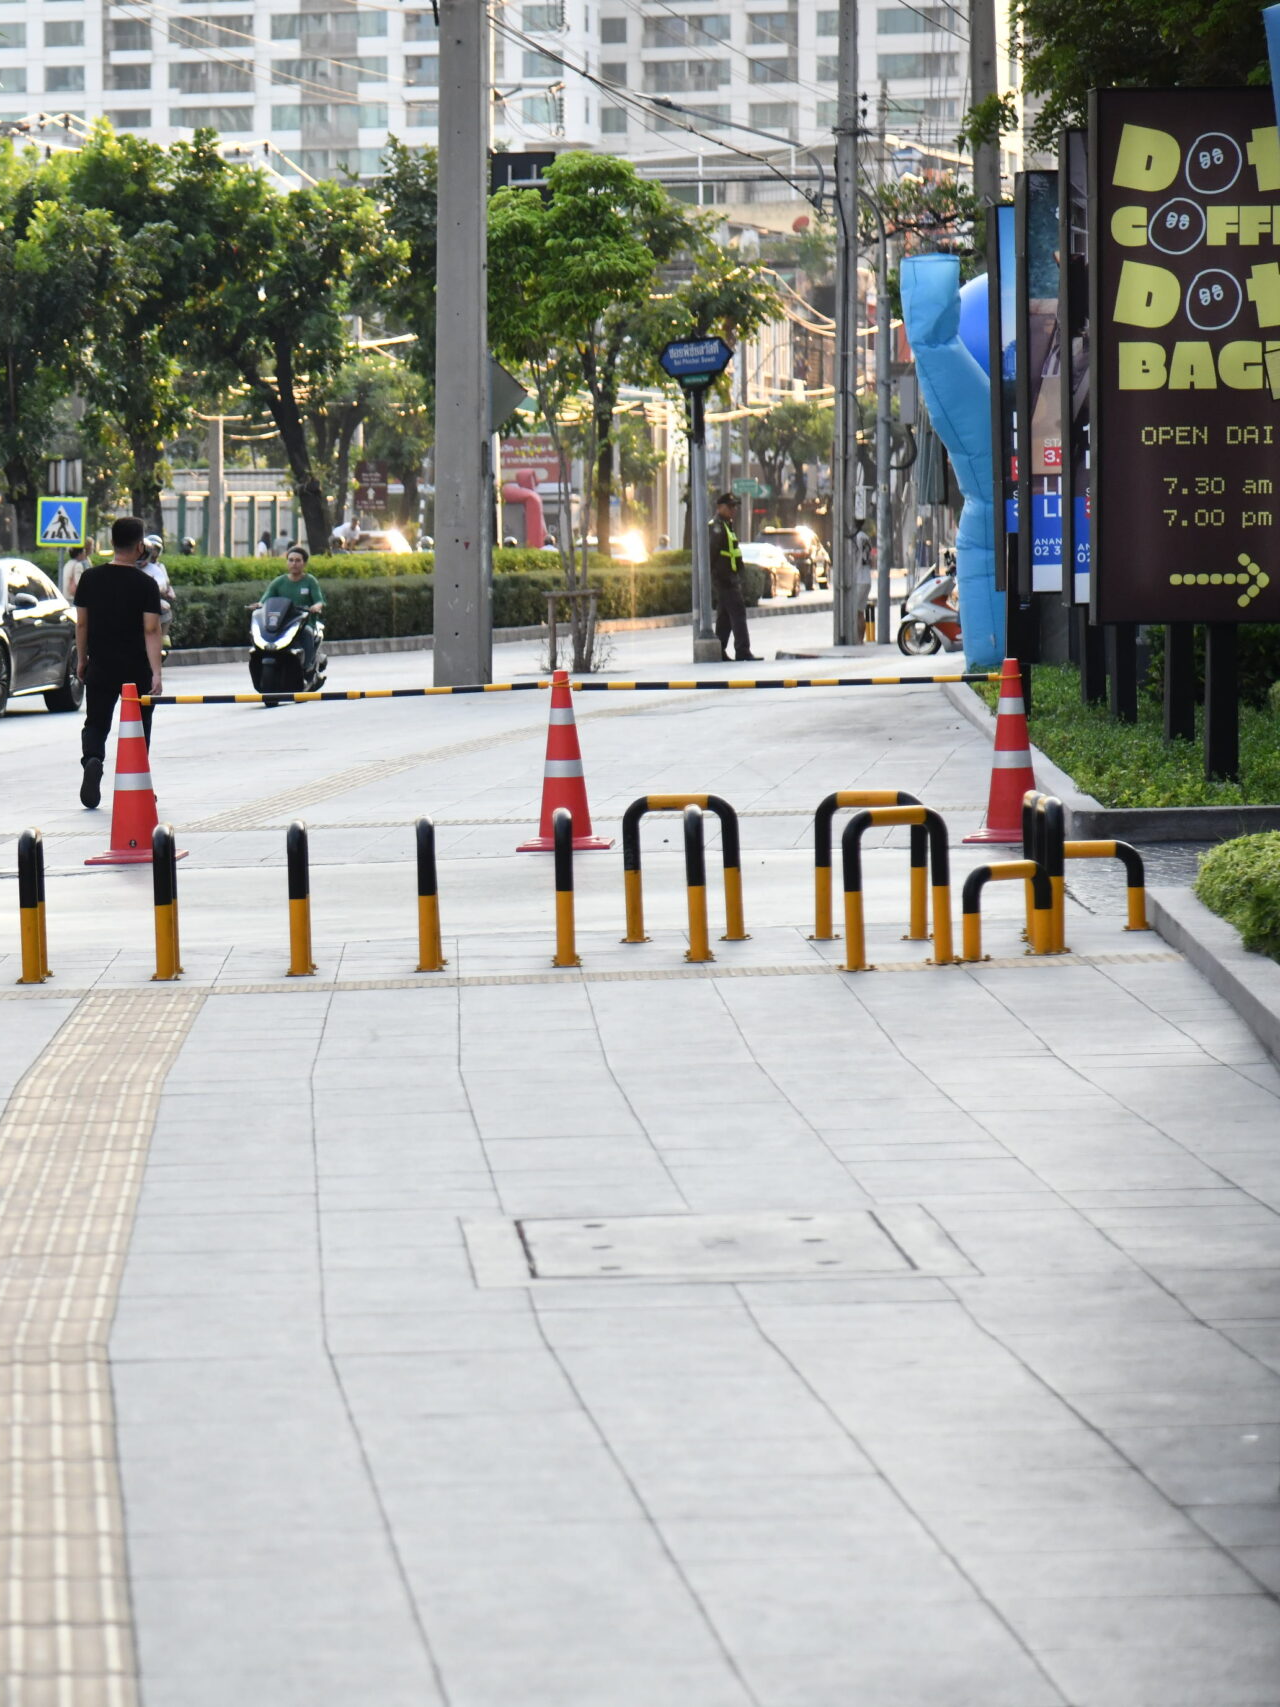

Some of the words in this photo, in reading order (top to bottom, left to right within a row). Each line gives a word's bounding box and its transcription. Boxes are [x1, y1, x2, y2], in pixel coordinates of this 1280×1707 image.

[1141, 426, 1208, 445] OPEN
[1163, 477, 1225, 494] 7.30
[1242, 480, 1273, 494] am
[1163, 509, 1225, 526] 7.00
[1242, 511, 1273, 528] pm
[1034, 546, 1050, 556] 02
